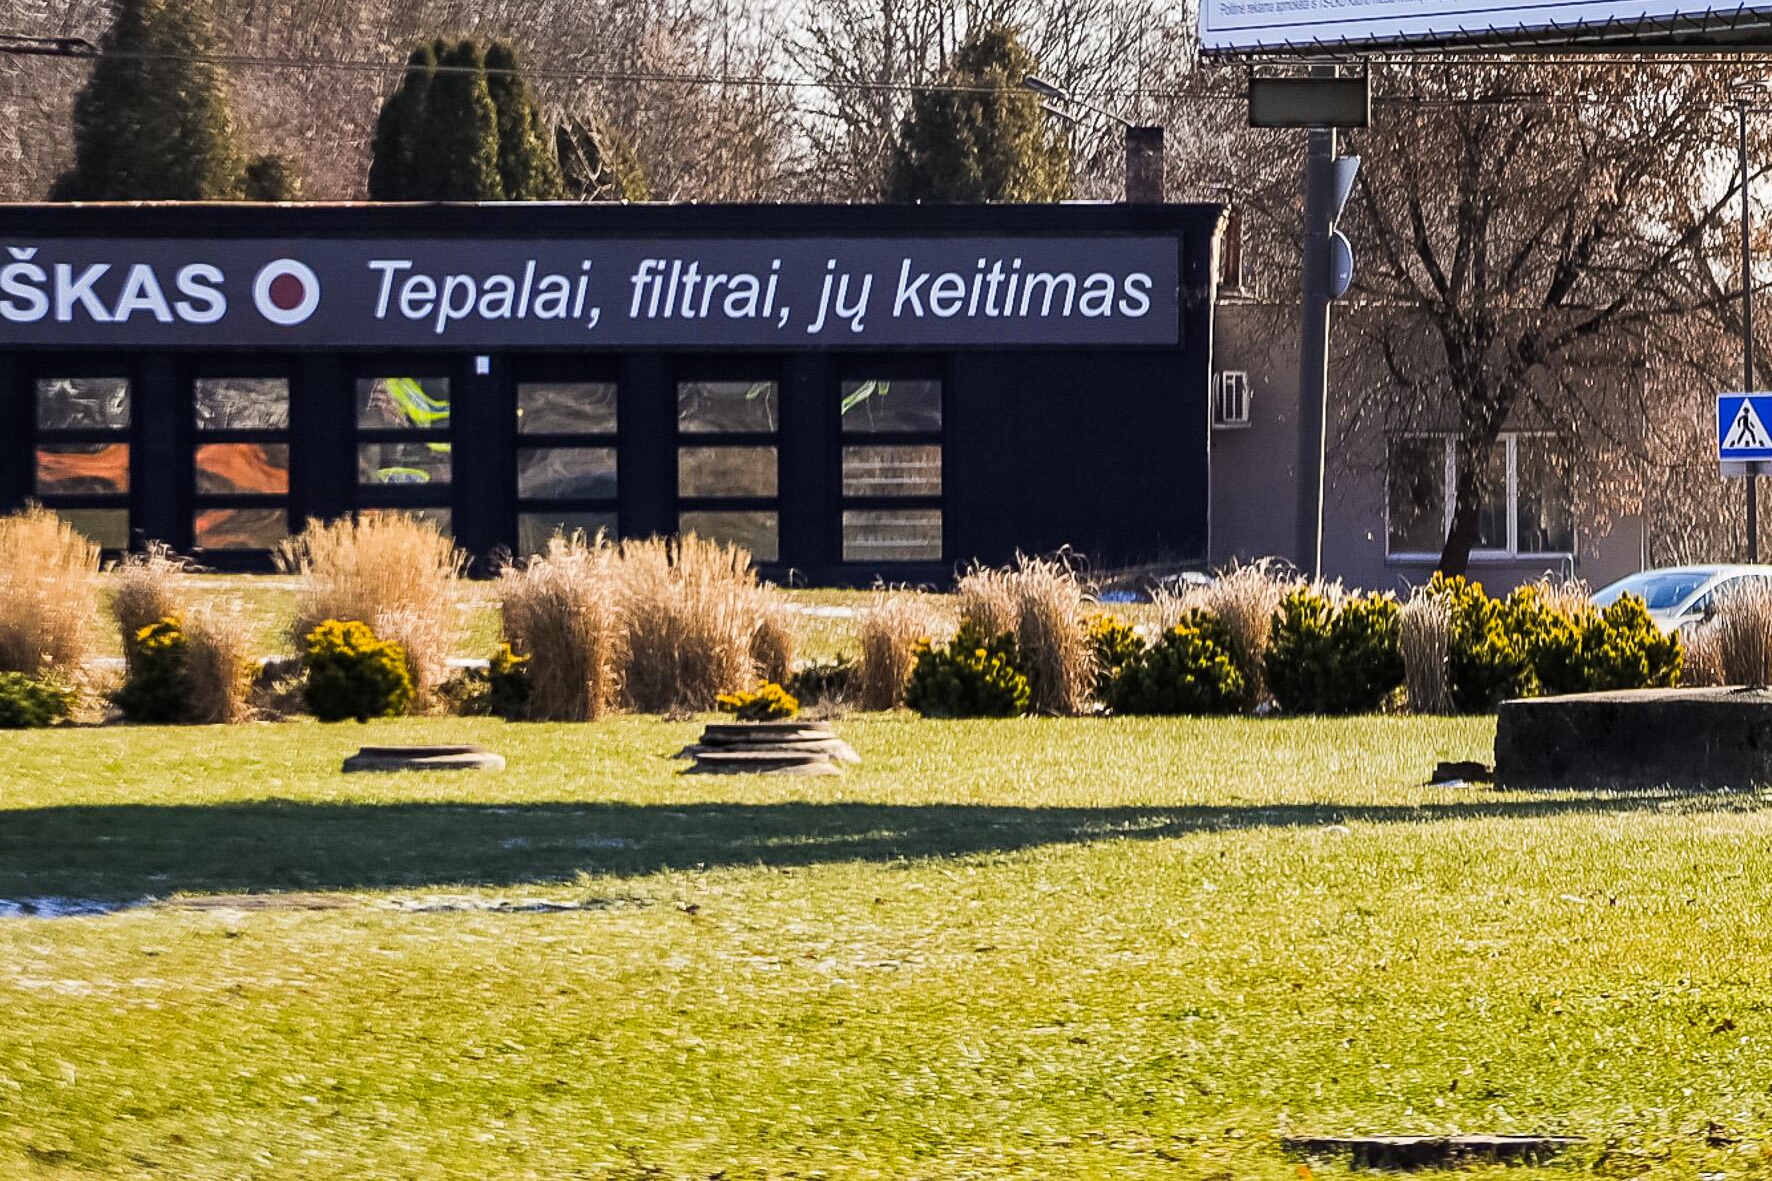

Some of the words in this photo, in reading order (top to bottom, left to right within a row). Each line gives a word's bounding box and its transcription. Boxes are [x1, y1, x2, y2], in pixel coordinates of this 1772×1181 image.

[0, 247, 227, 323] ŠKAS
[368, 260, 601, 334] Tepalai,
[629, 259, 791, 330] filtrai,
[807, 259, 872, 333] jų
[893, 258, 1153, 318] keitimas
